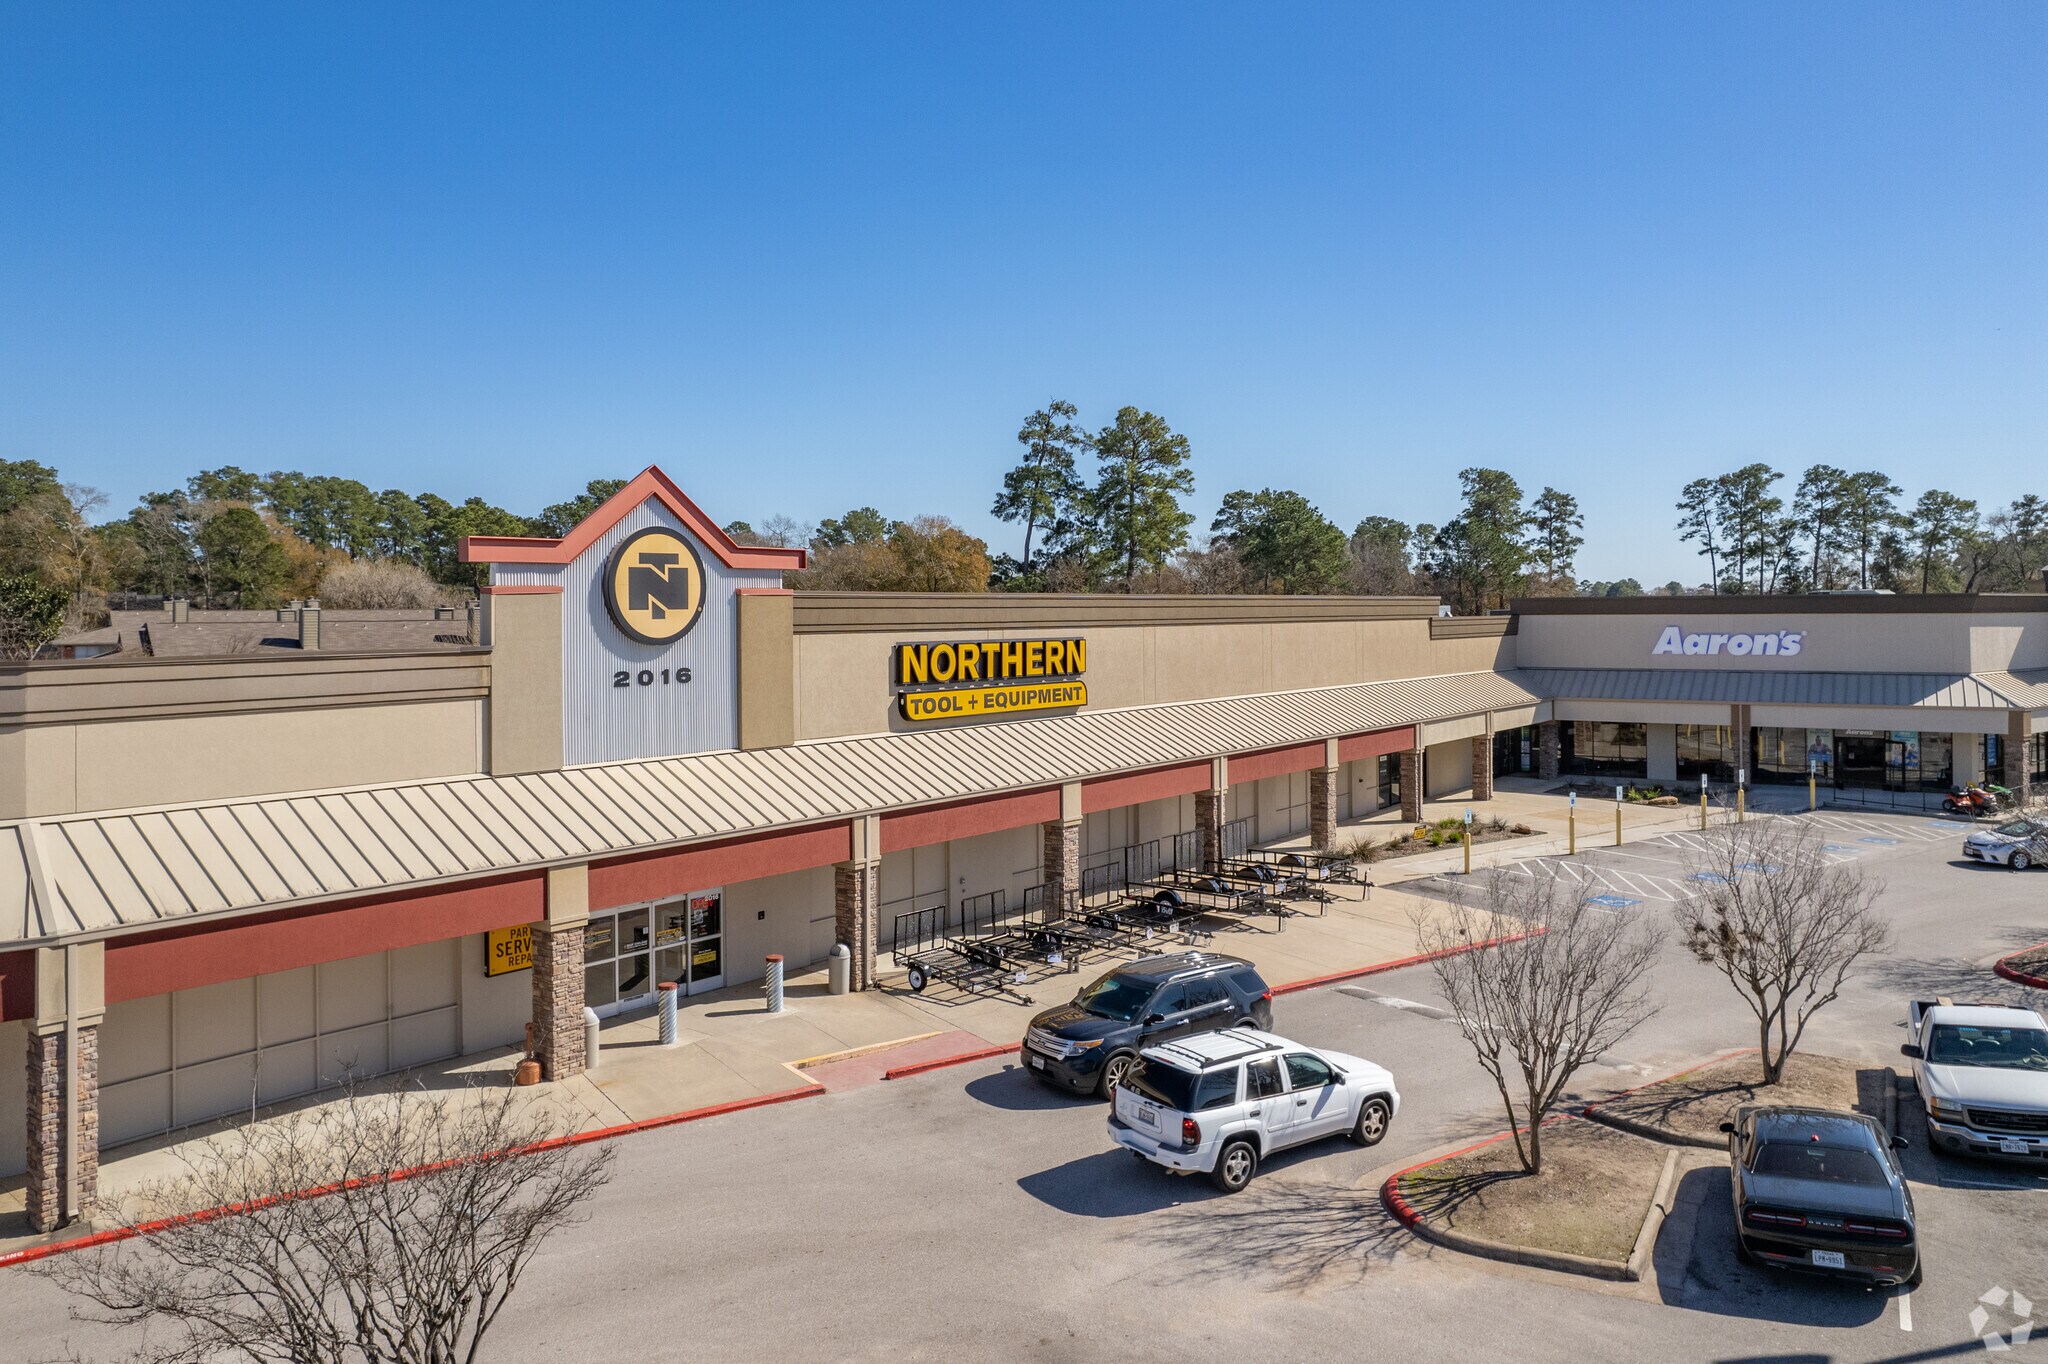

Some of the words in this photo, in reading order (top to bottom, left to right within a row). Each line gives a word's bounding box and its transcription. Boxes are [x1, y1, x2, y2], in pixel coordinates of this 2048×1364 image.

[902, 638, 1086, 684] NORTHERN
[613, 667, 692, 688] 2016
[910, 696, 963, 715] TOOL
[983, 686, 1083, 710] EQUIPMENT
[496, 936, 533, 958] SERV
